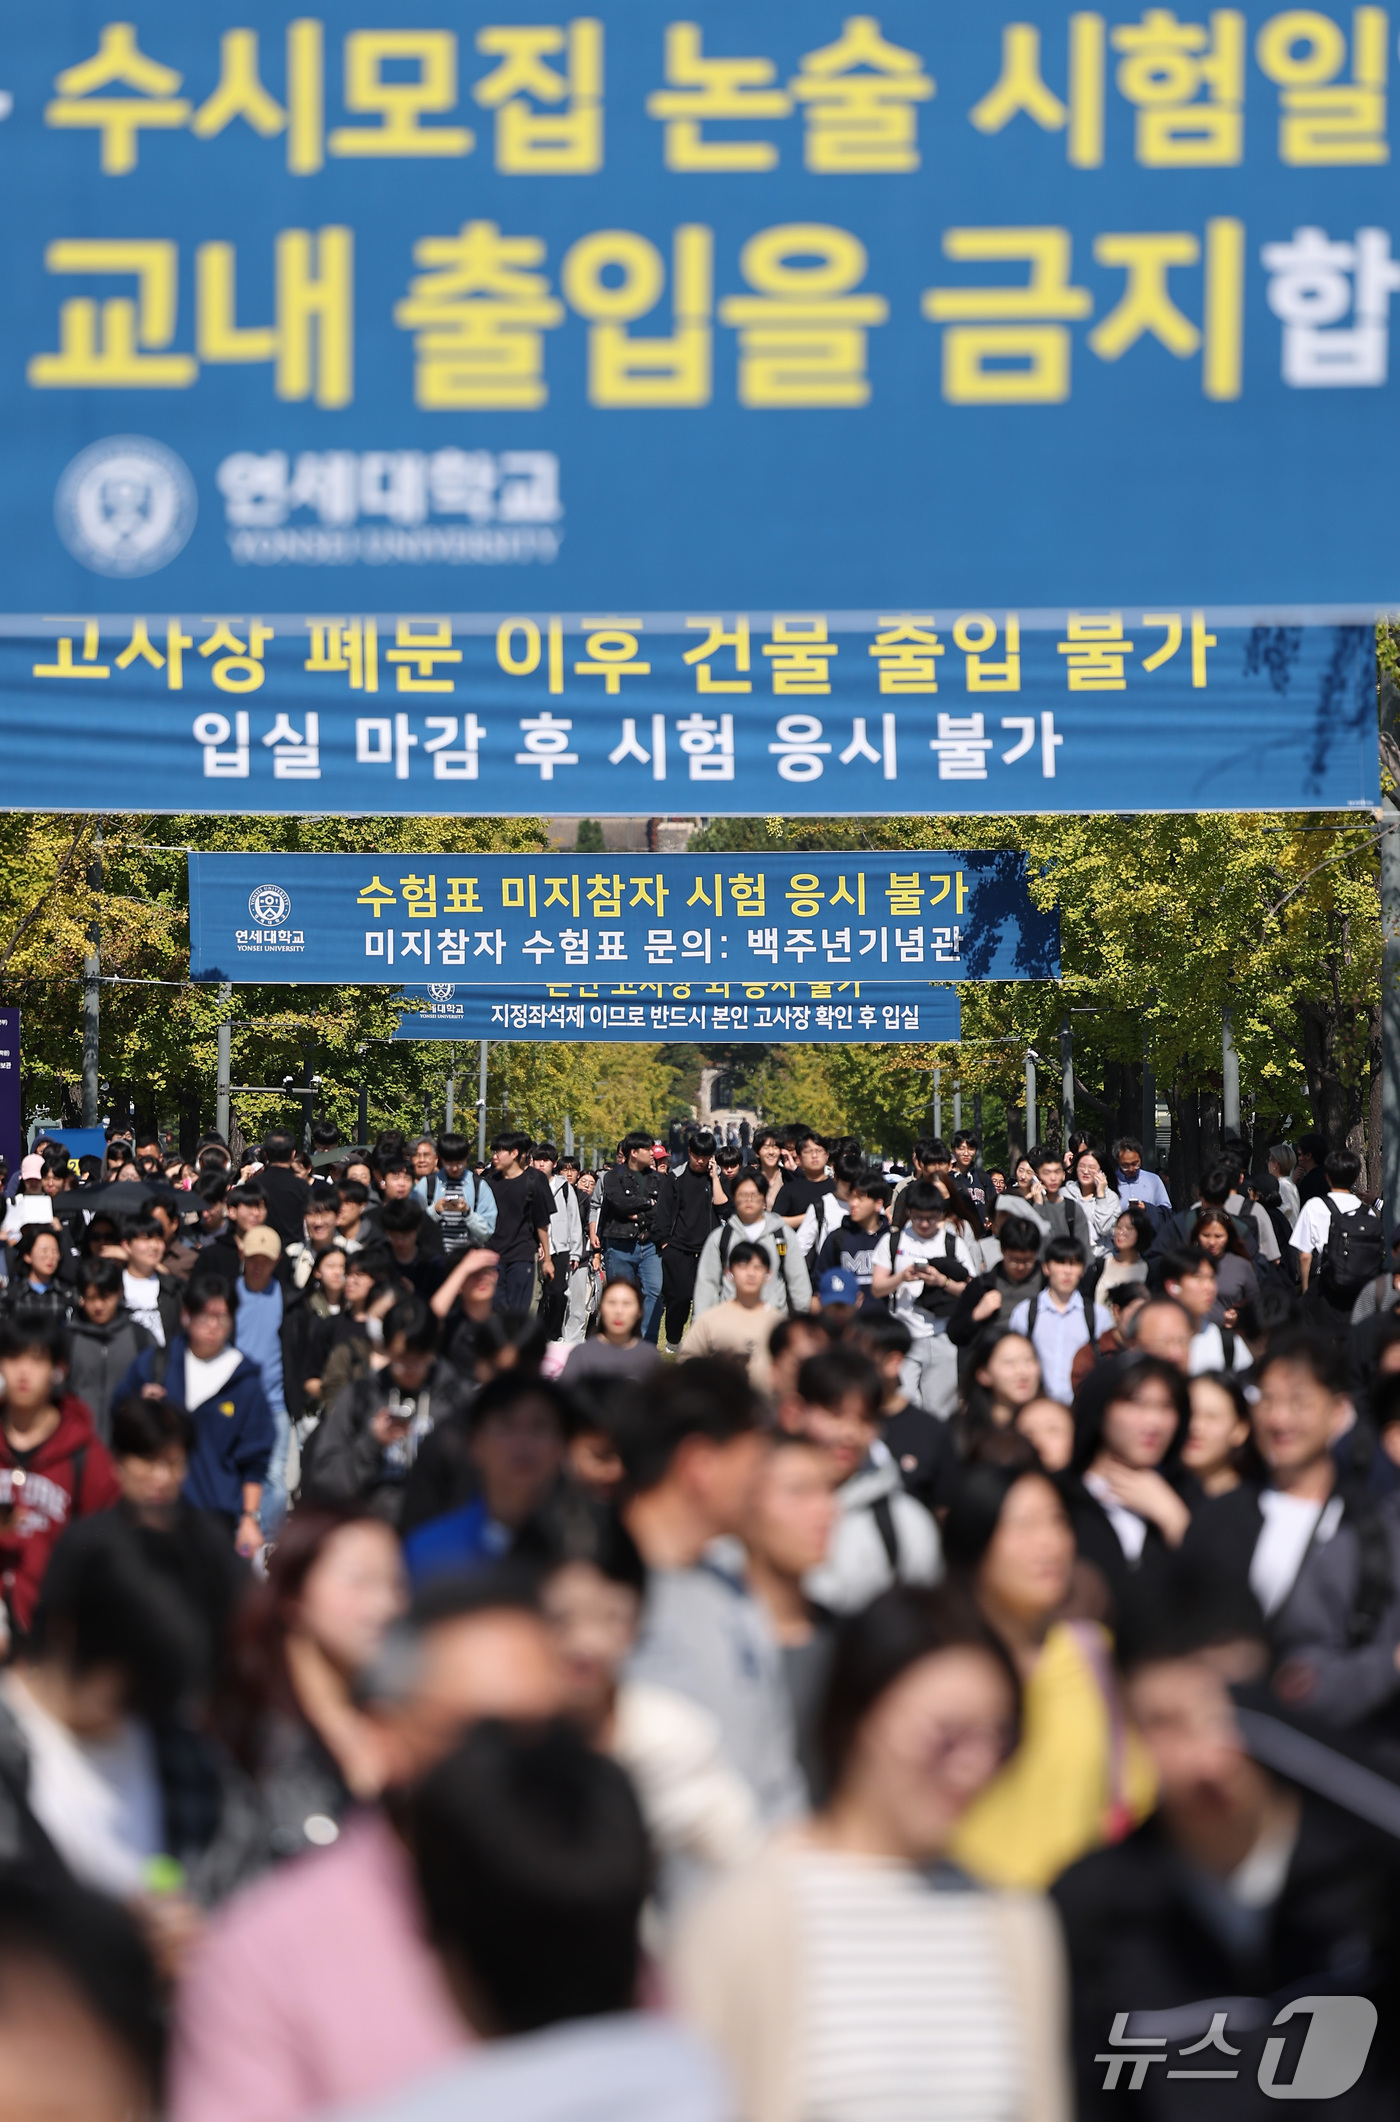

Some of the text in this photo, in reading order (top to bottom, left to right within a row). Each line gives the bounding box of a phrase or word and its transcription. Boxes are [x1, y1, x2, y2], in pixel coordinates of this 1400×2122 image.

[46, 7, 1388, 174] 수시모집 논술 시험일
[29, 226, 352, 408] 교내
[395, 221, 888, 409] 출입을
[304, 616, 463, 693] 폐문
[496, 615, 651, 693] 이후
[682, 613, 838, 694] 건물
[868, 612, 1021, 693] 출입
[1056, 611, 1217, 690] 불가
[193, 711, 1063, 782] 입실 마감 후 시험 응시 불가
[357, 872, 968, 917] 수험표 미지참자 시험 응시 불가
[235, 930, 304, 944] 연세대학교
[366, 926, 963, 964] 미지참자 수험표 문의: 백주년기념관
[420, 1004, 464, 1014] 세대학교
[491, 1004, 919, 1030] 지정좌석제 이므로 반드시 본인 고사장 확인 후 입실
